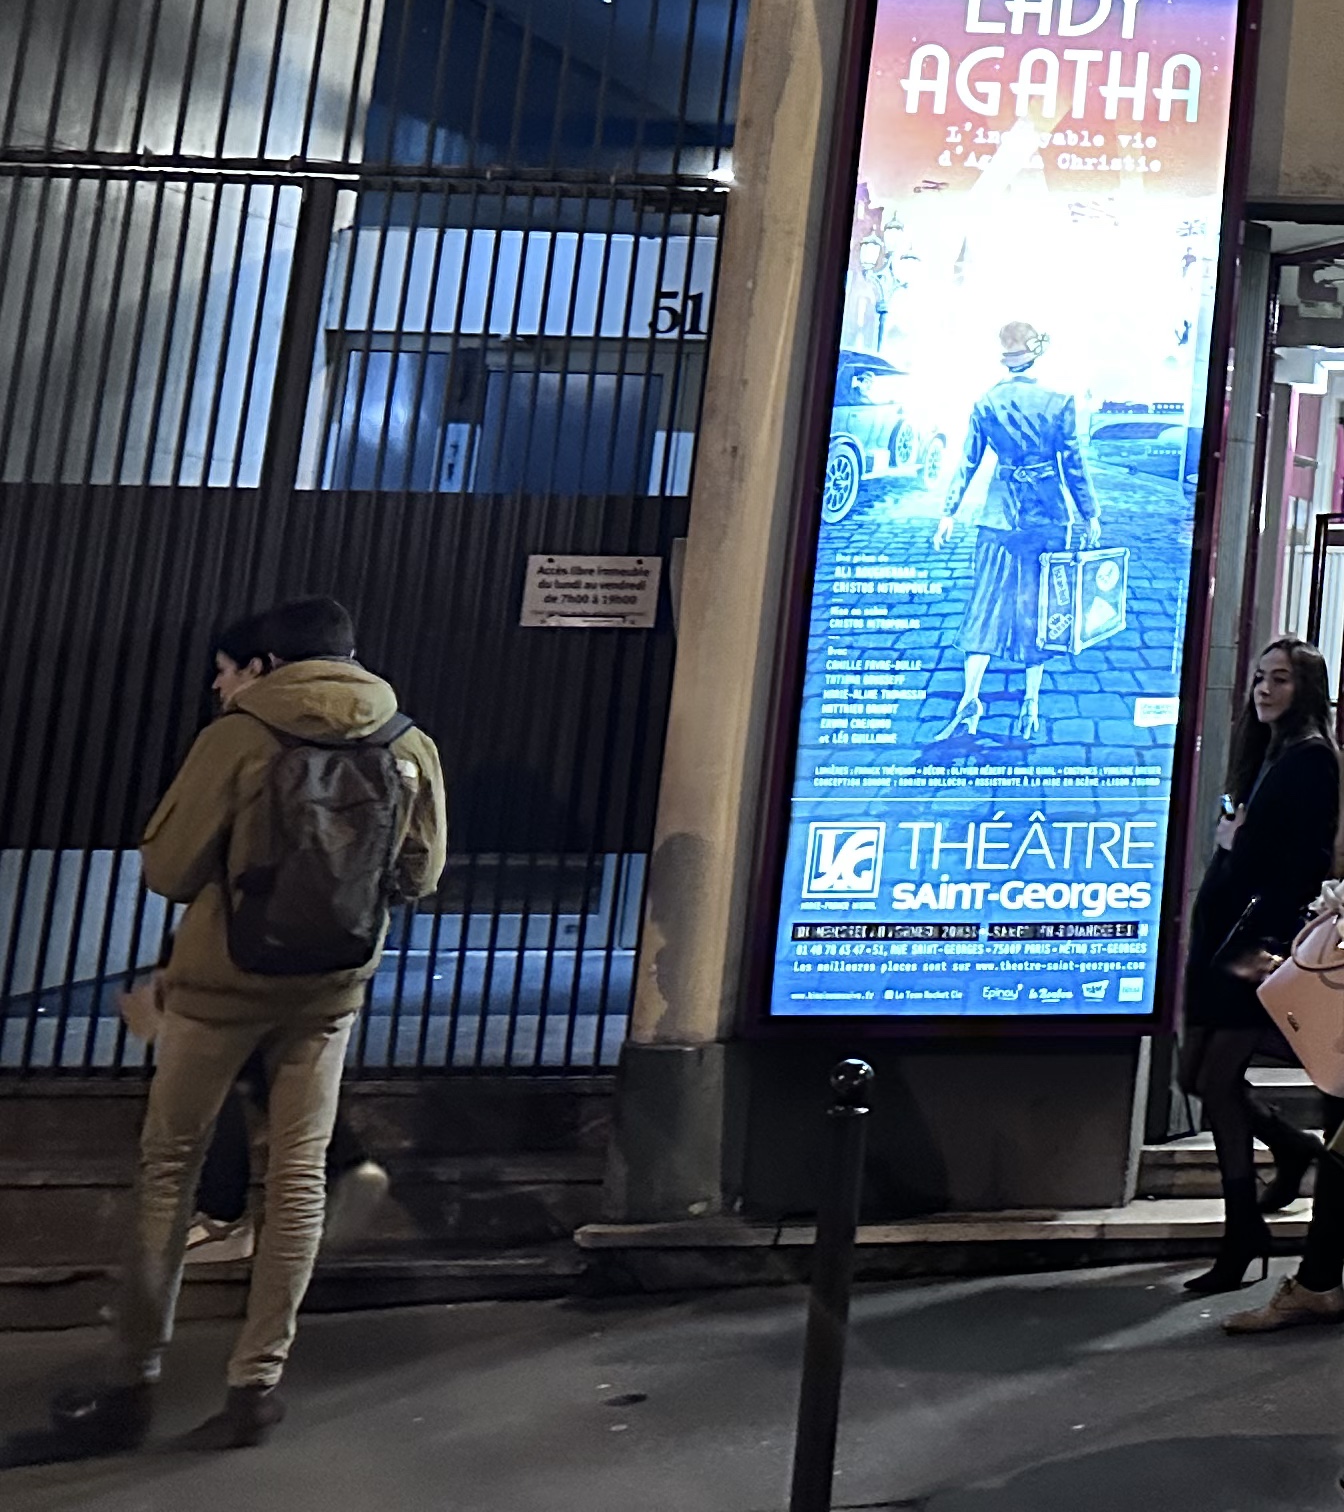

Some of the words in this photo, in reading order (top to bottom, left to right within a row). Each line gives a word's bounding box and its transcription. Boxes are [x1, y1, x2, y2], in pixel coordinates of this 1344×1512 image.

[900, 44, 1202, 123] AGATHA
[946, 121, 1105, 148] L'inyable
[1117, 131, 1157, 148] vie
[938, 145, 1045, 170] d'Aga
[1057, 153, 1162, 172] Christie
[648, 291, 708, 334] 51
[544, 594, 558, 603] de
[560, 594, 589, 604] 7h00
[898, 810, 1157, 870] THÉÂTRE
[793, 961, 812, 972] Les
